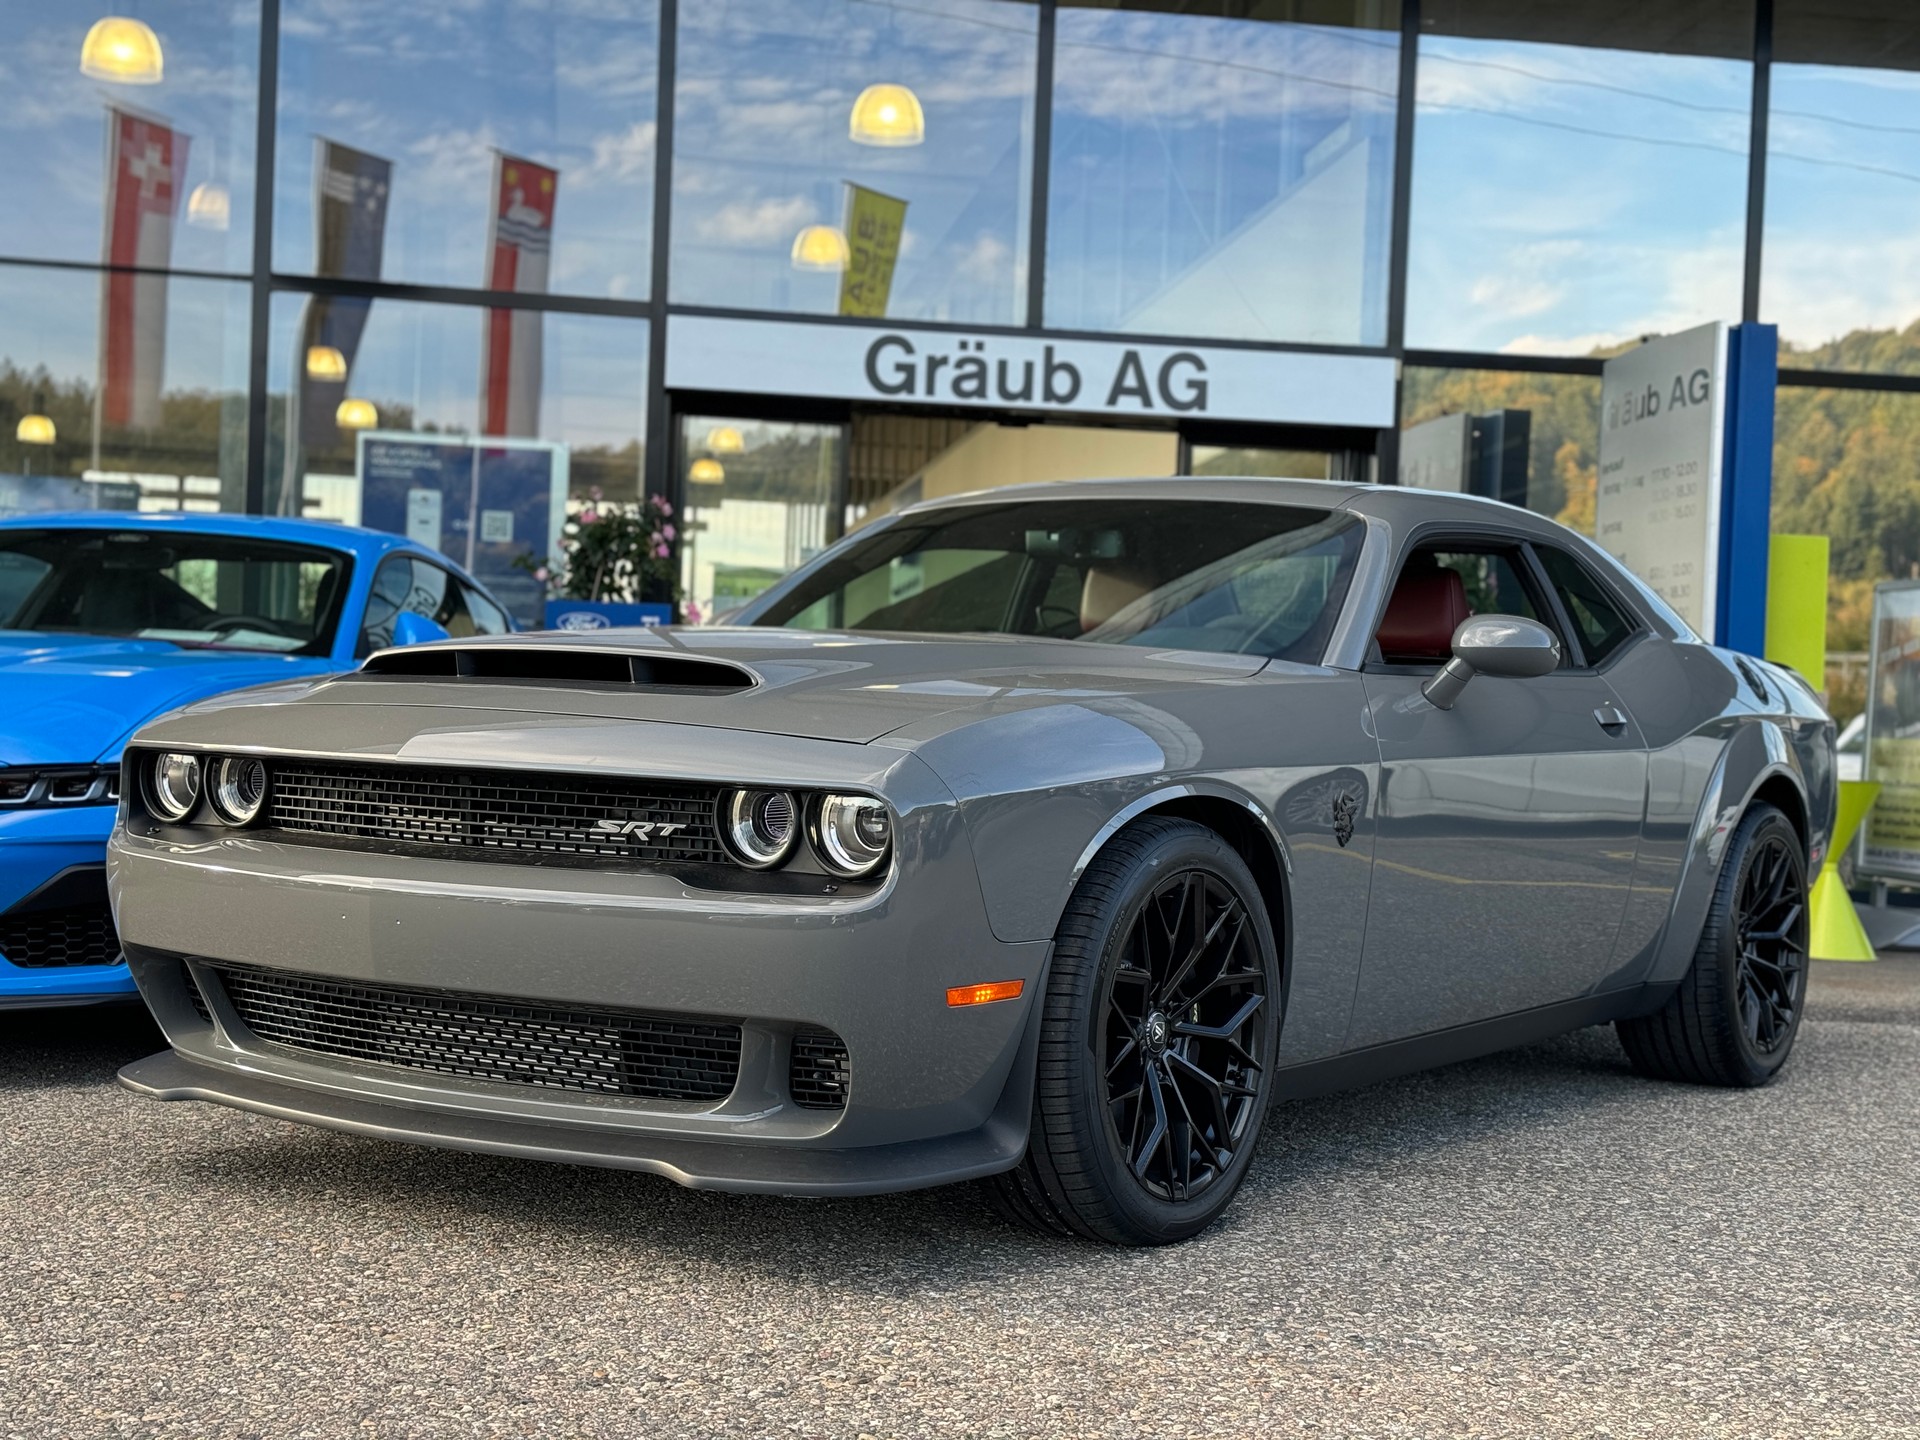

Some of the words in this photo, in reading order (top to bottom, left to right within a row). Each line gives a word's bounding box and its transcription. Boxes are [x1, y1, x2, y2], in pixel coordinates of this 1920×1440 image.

[865, 334, 1082, 405] Gräub
[1105, 349, 1209, 412] AG
[1668, 368, 1710, 412] AG
[589, 819, 687, 841] SRT
